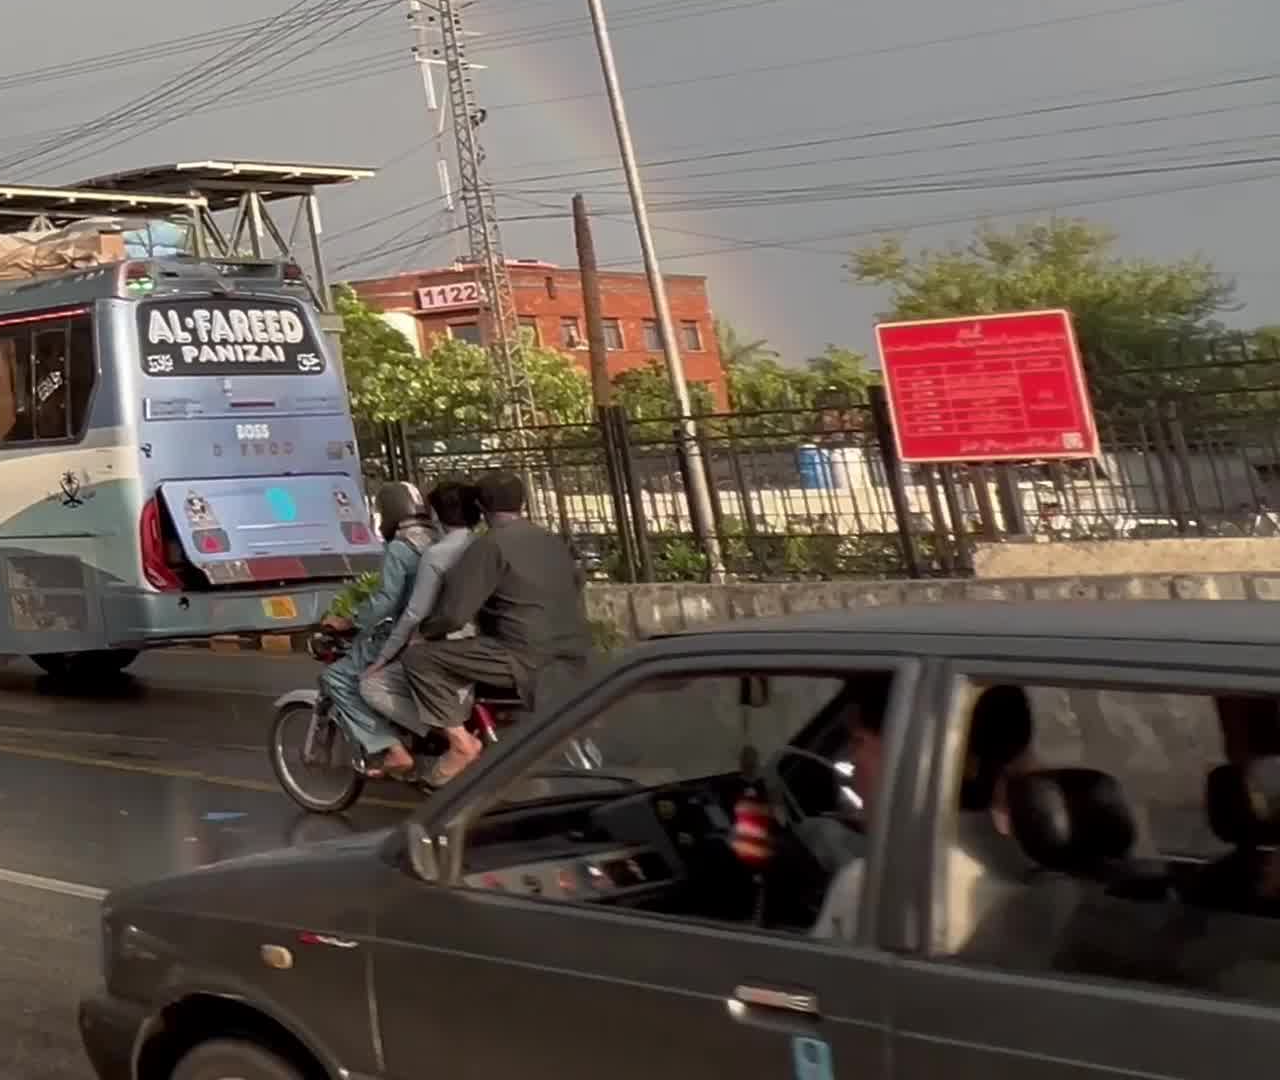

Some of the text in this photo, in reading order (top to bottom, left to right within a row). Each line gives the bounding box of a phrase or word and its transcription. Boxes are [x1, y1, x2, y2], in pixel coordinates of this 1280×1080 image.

[423, 285, 477, 305] 1122
[181, 345, 286, 363] PANIZAI
[236, 423, 270, 439] BOSS
